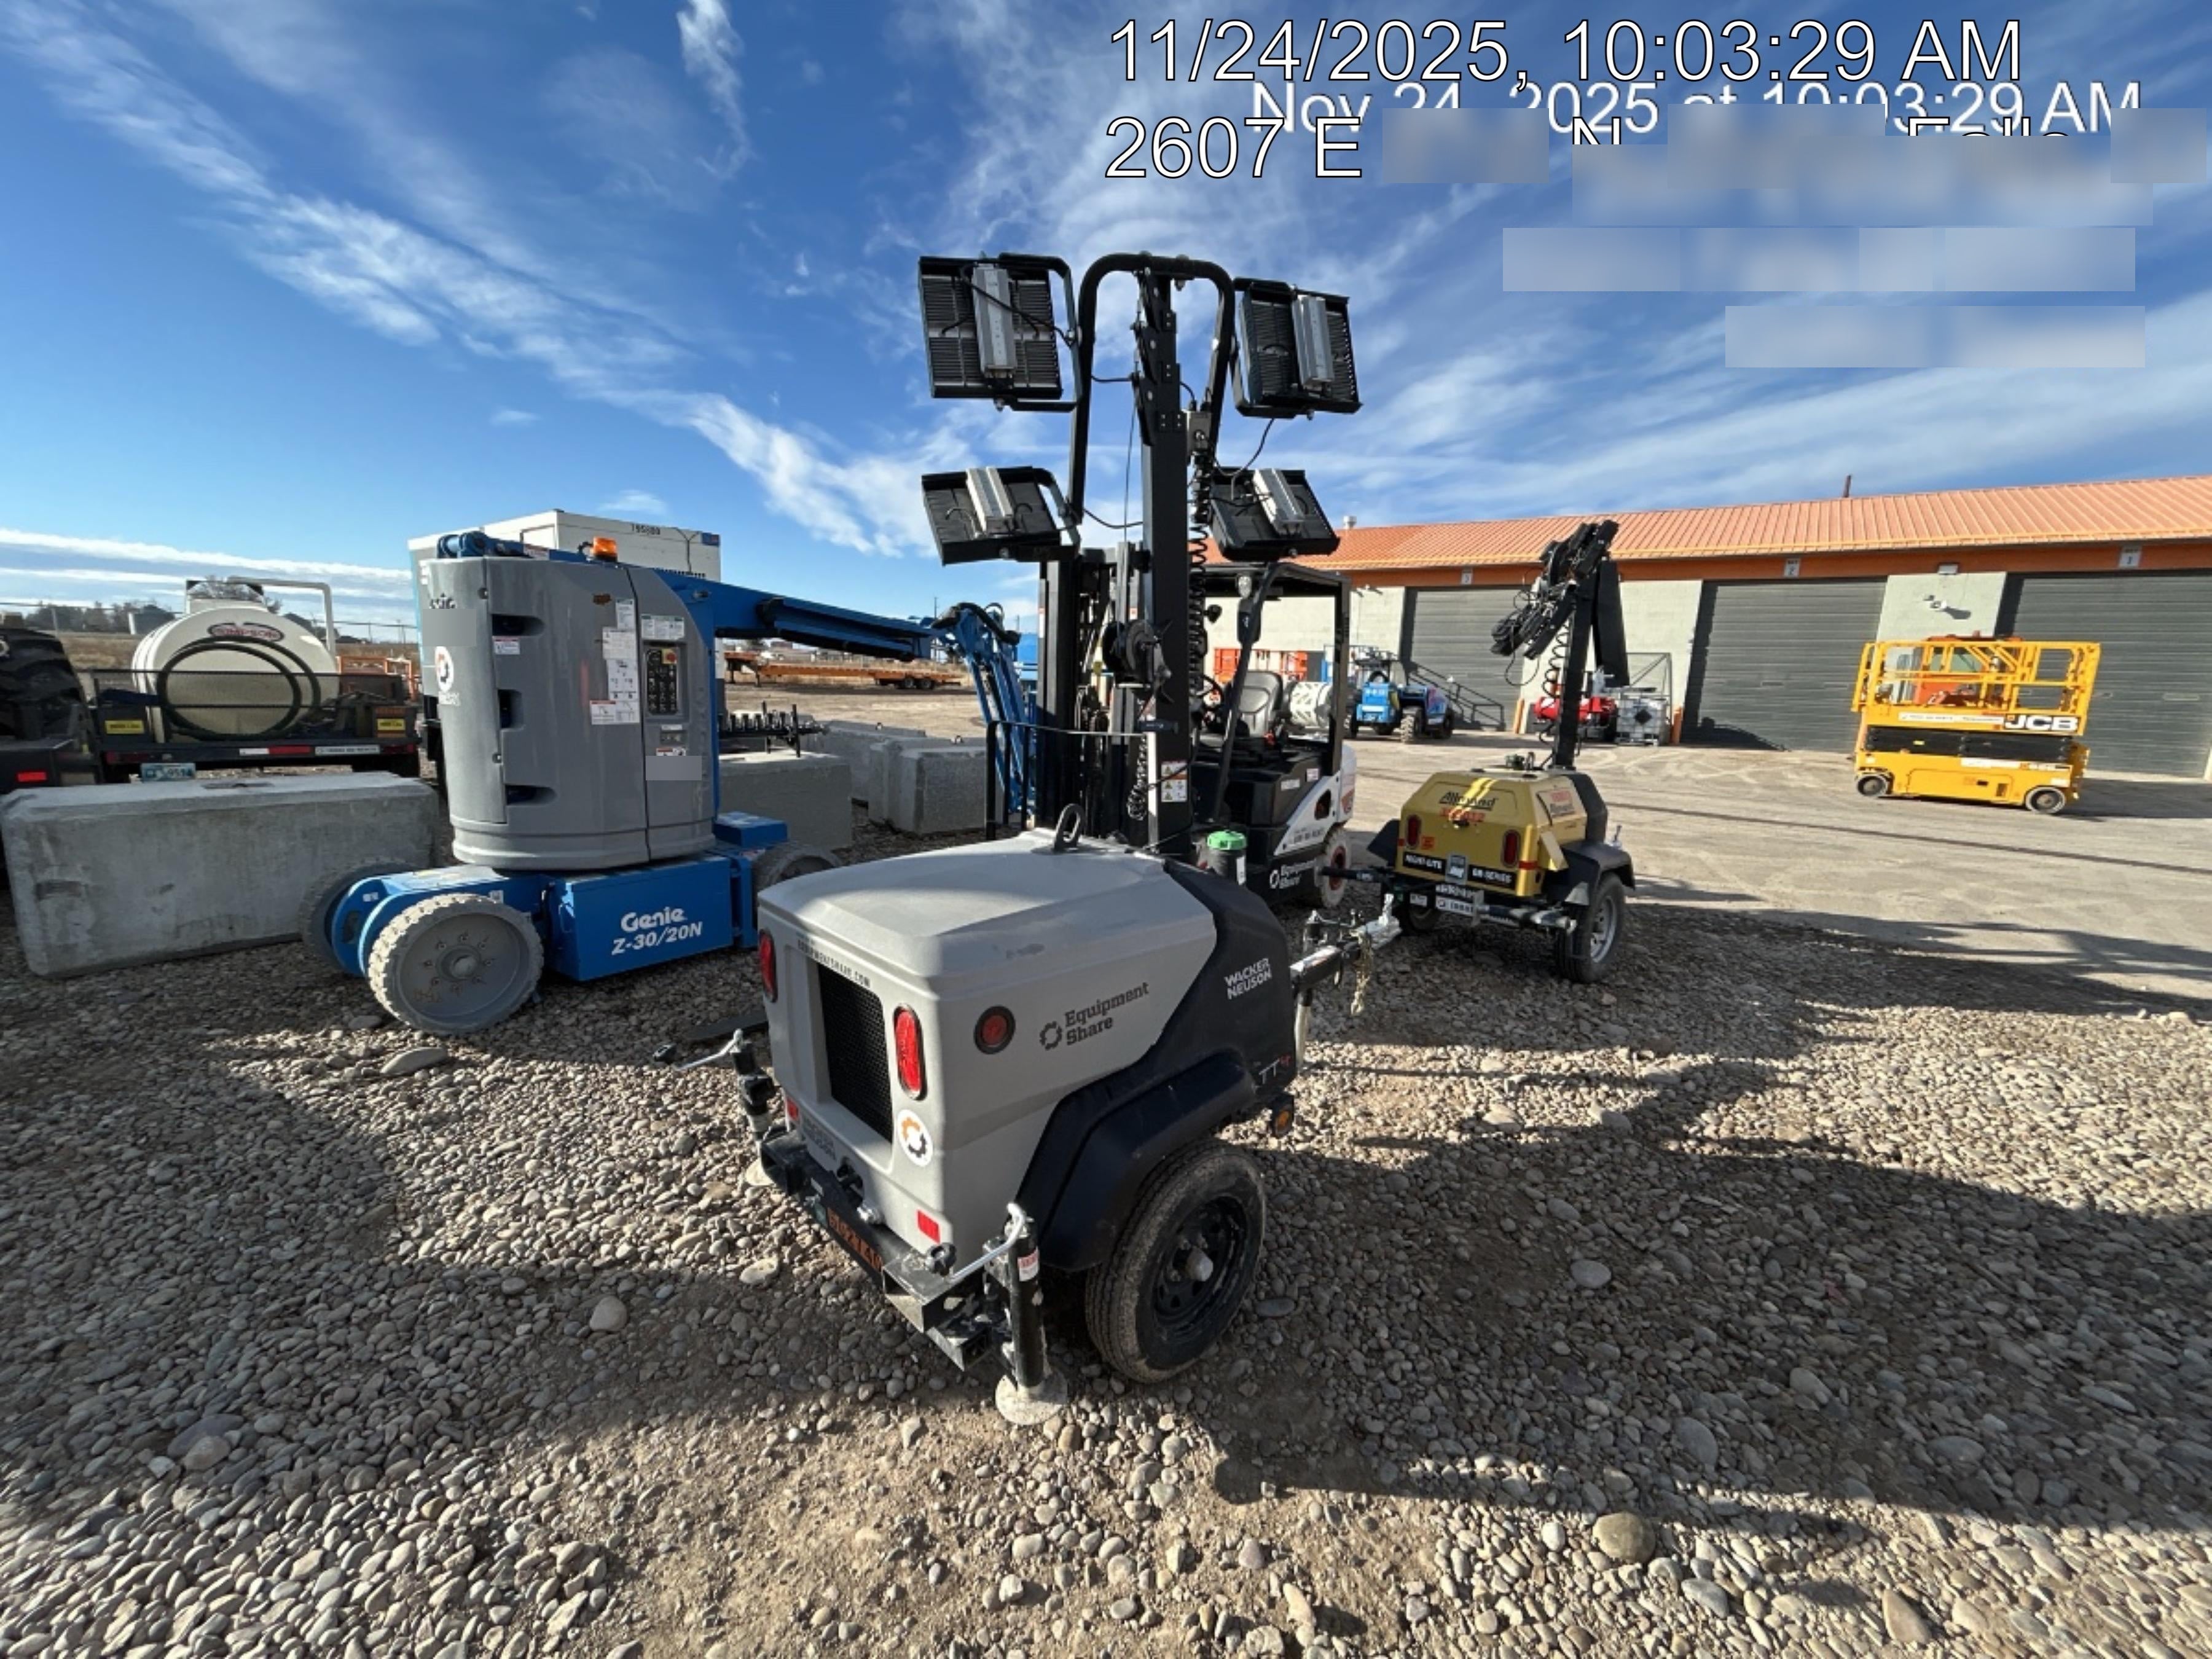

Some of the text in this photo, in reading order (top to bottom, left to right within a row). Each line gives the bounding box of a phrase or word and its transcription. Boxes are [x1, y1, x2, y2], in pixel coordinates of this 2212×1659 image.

[2004, 715, 2079, 731] JCB
[621, 906, 688, 933] Genie
[611, 921, 704, 956] Z-30/20N
[1223, 957, 1270, 987] WACKER
[1226, 967, 1273, 1000] NEUSON
[1064, 981, 1150, 1028] Equipment
[1066, 1016, 1113, 1046] Share
